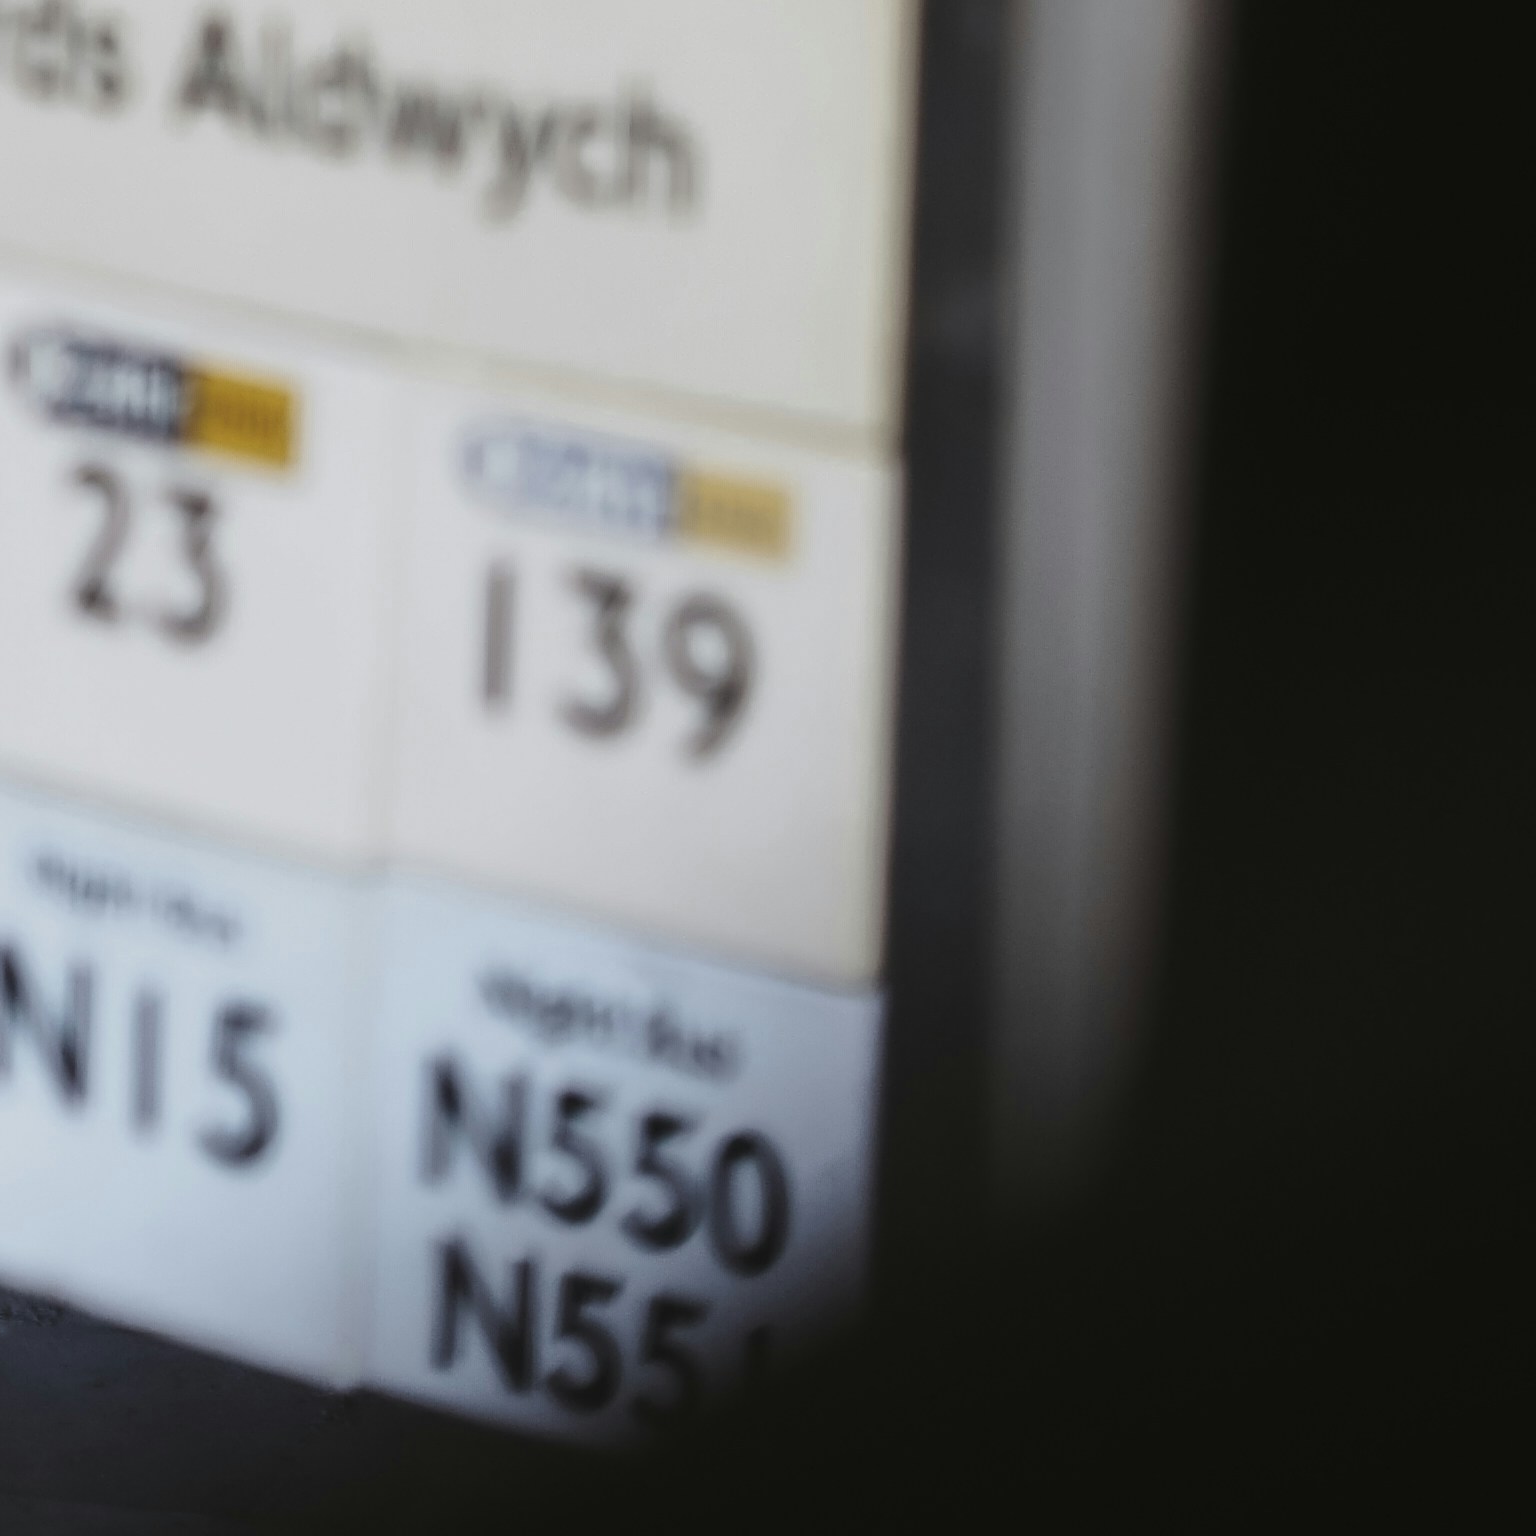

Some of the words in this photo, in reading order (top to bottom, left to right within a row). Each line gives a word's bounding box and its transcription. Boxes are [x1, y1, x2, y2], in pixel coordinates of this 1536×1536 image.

[174, 8, 706, 224] Aldwych
[65, 460, 229, 646] 23
[478, 552, 760, 766] 139
[417, 1050, 794, 1278] N550
